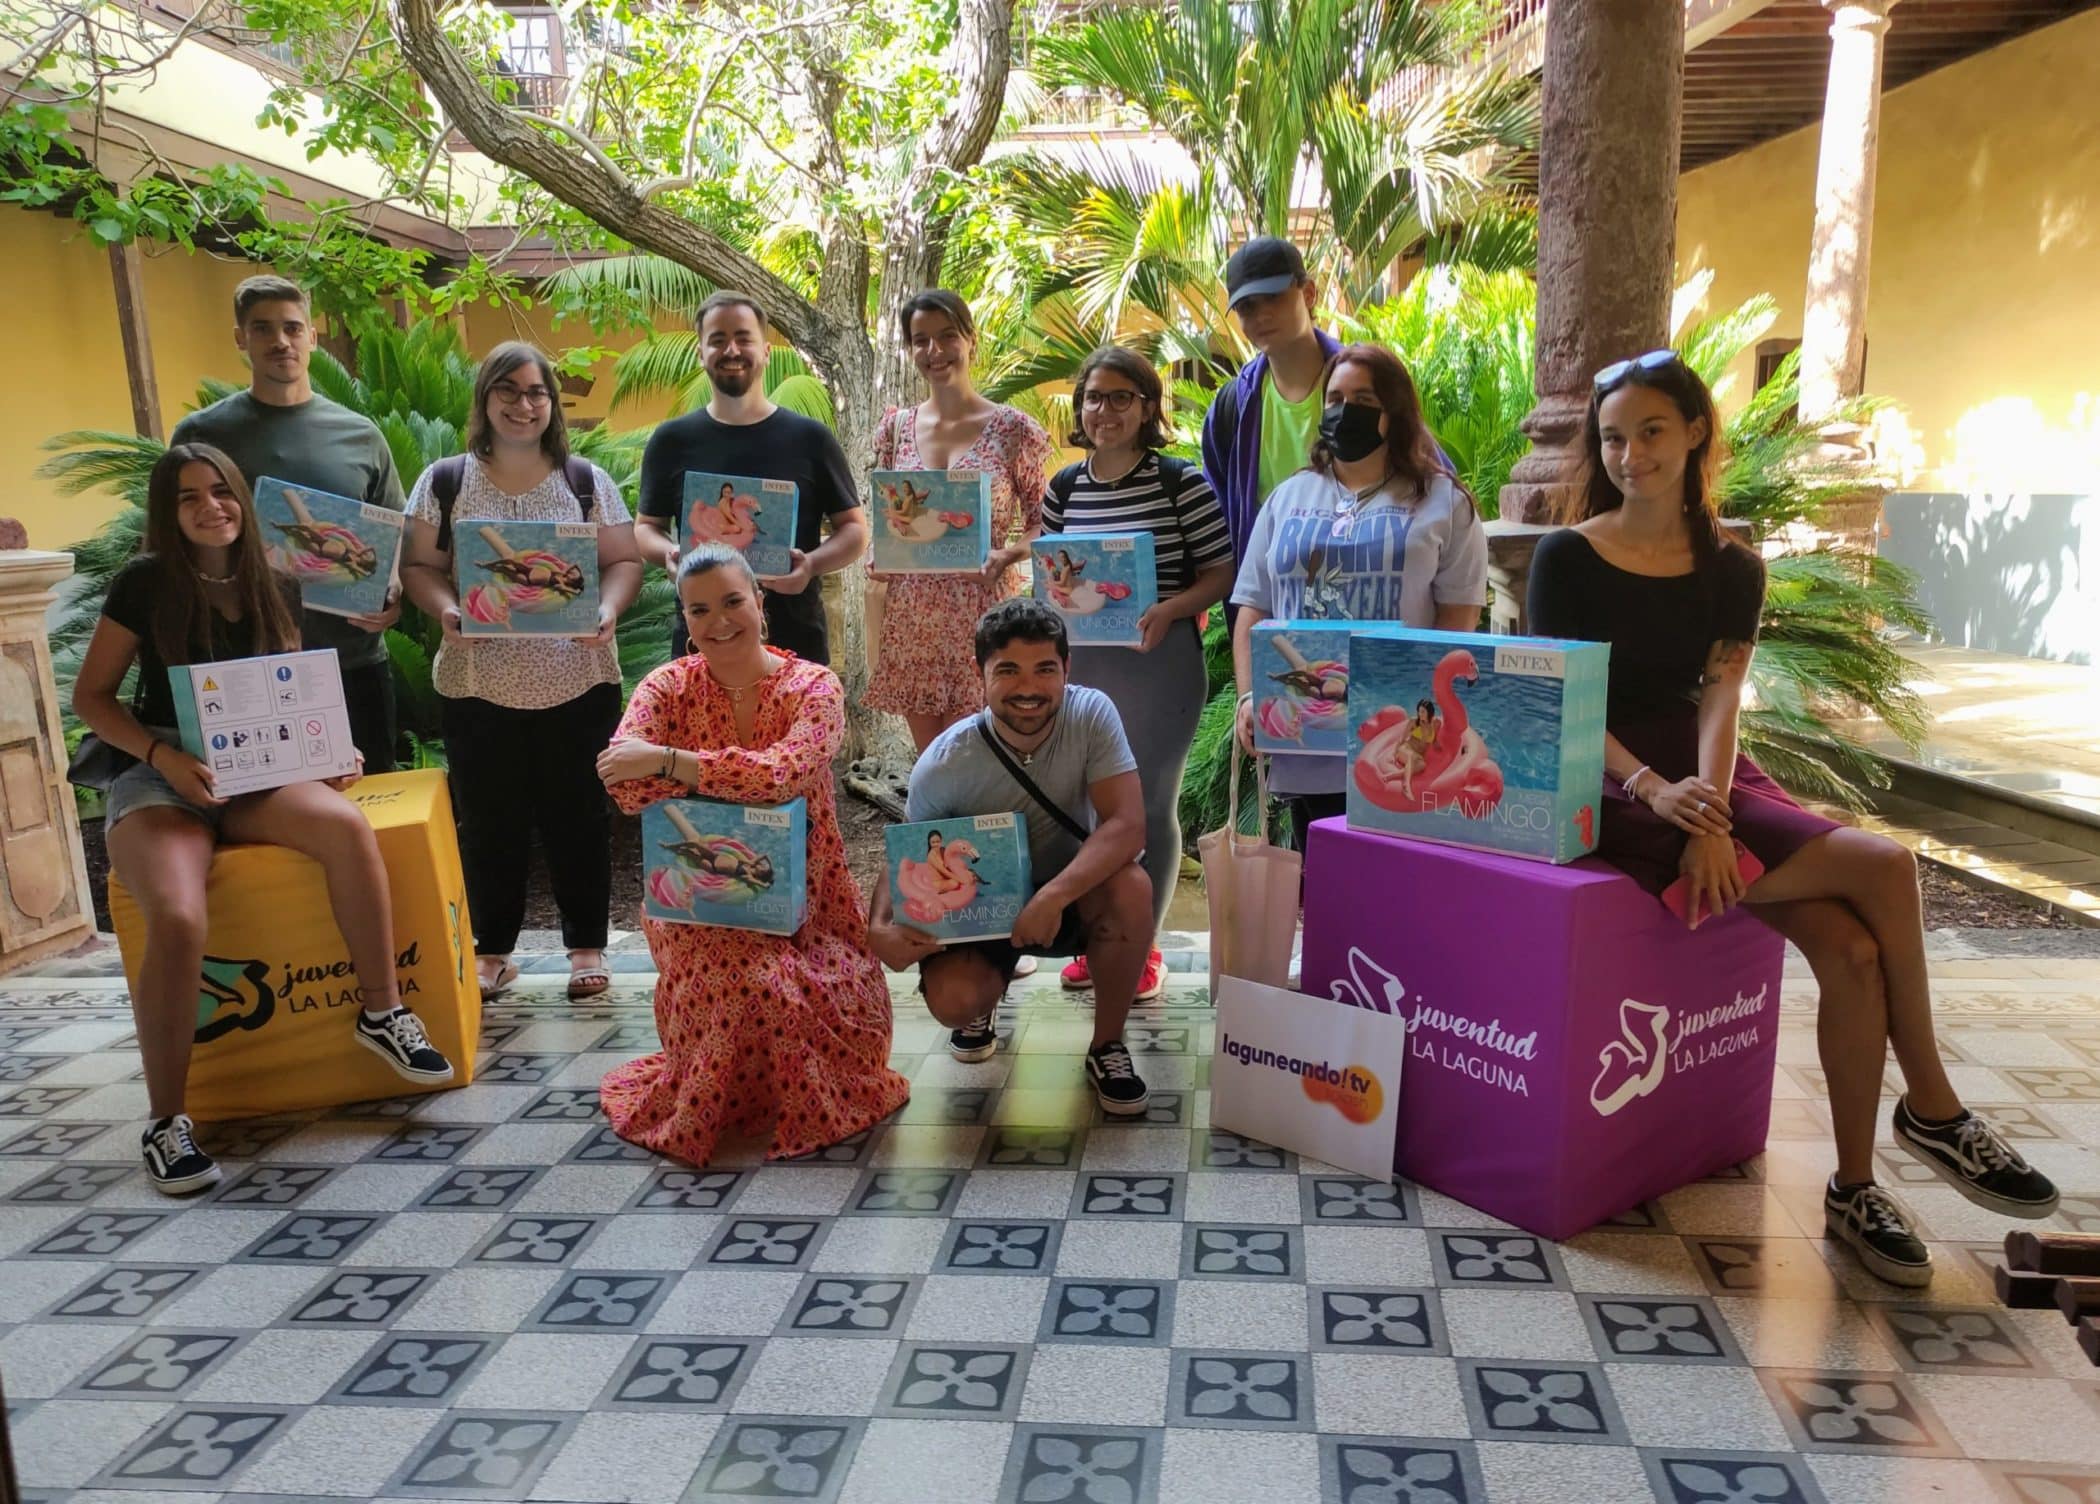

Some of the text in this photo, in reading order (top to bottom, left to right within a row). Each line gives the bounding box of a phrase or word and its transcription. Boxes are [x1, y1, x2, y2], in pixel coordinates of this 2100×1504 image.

[559, 526, 592, 536] INTEX
[919, 542, 978, 558] UNICORN
[1275, 515, 1416, 576] BUNNY
[1500, 653, 1554, 672] INTEX
[749, 811, 785, 825] INTEX
[976, 815, 1009, 828] INTEX
[1421, 791, 1552, 832] FLAMINGO
[746, 900, 787, 915] FLOAT
[940, 902, 1020, 924] FLAMINGO
[289, 995, 319, 1014] LA
[1406, 994, 1538, 1061] juventud
[1668, 982, 1768, 1055] juventud
[1674, 1026, 1759, 1074] LA LAGUNA
[1412, 1035, 1529, 1098] LA LAGUNA
